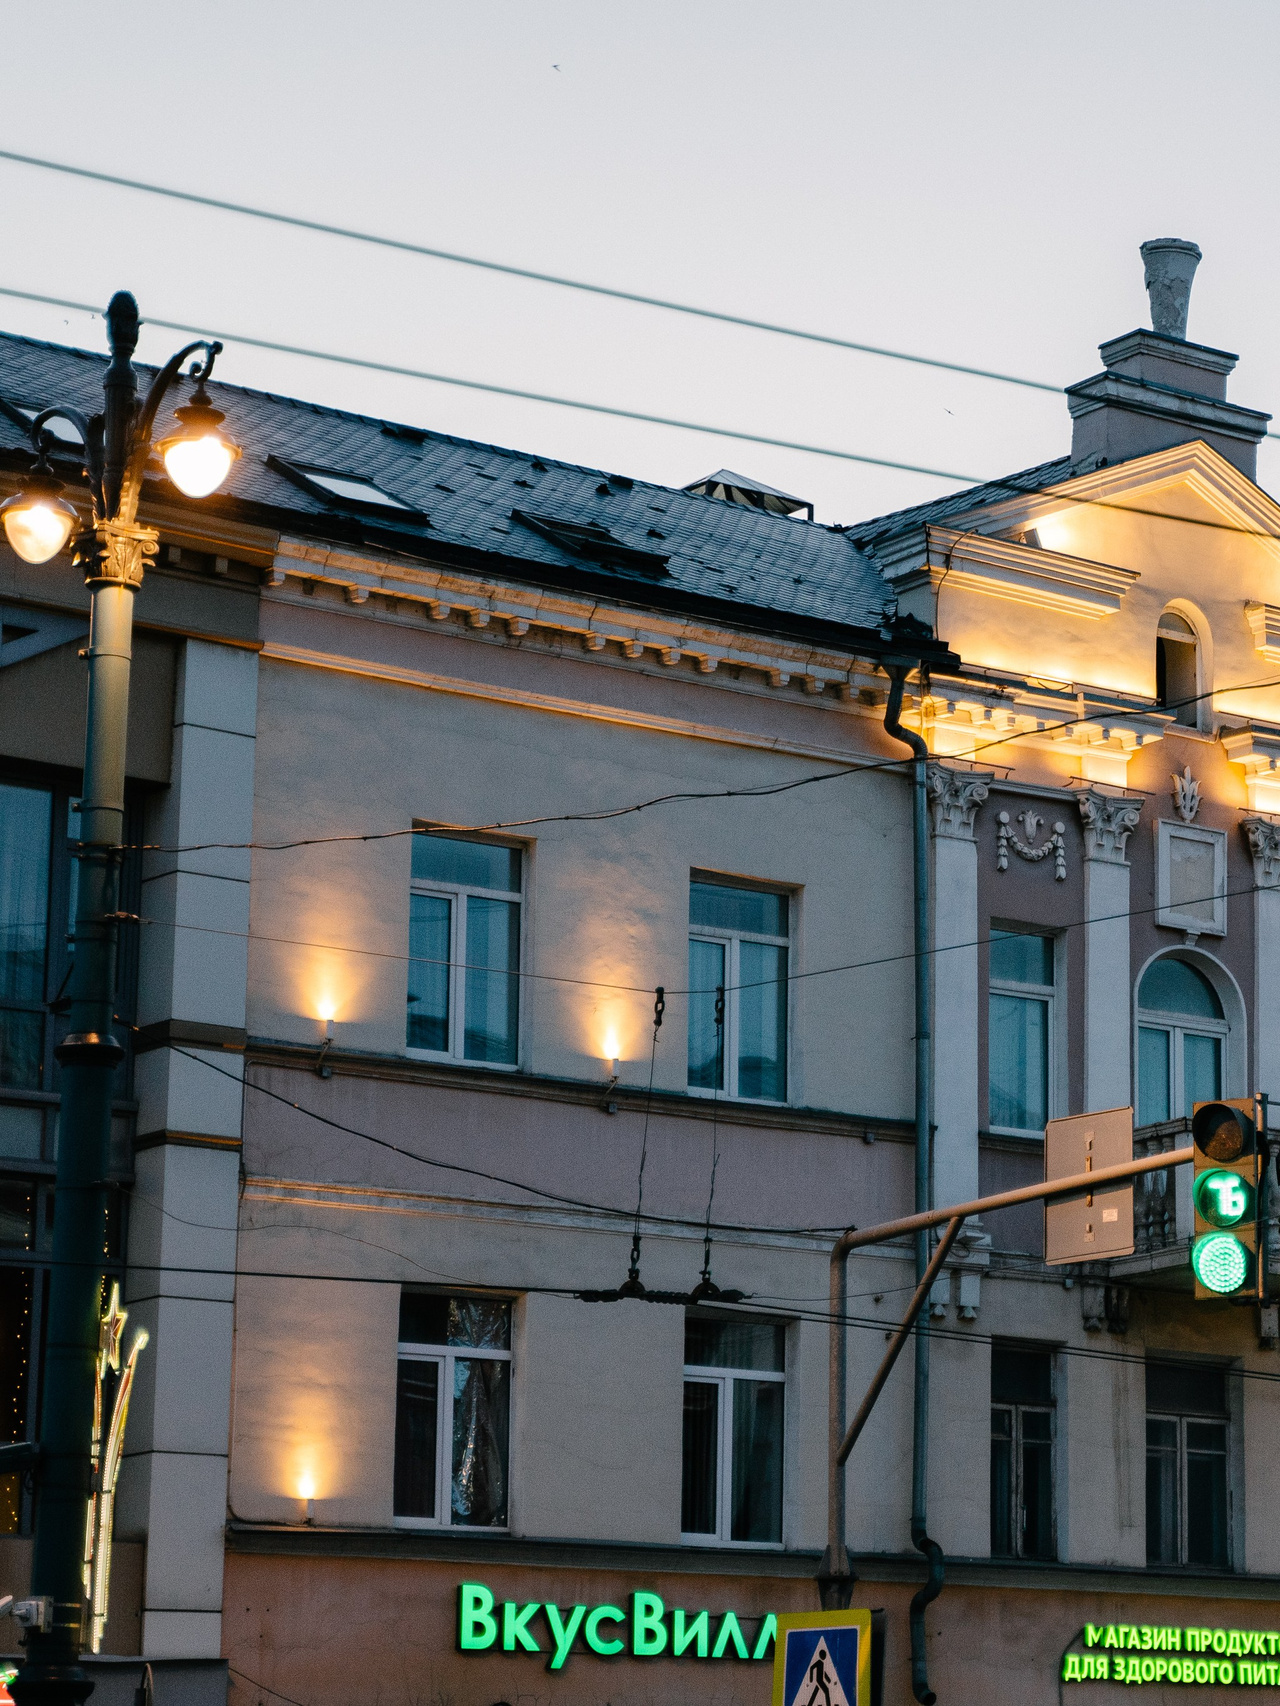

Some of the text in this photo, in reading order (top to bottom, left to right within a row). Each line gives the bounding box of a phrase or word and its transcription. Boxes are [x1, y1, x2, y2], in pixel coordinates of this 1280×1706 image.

[1085, 1623, 1181, 1651] МАГАЗИН
[1063, 1654, 1109, 1682] ДЛЯ
[1113, 1657, 1235, 1684] ЗДОРОВОГО
